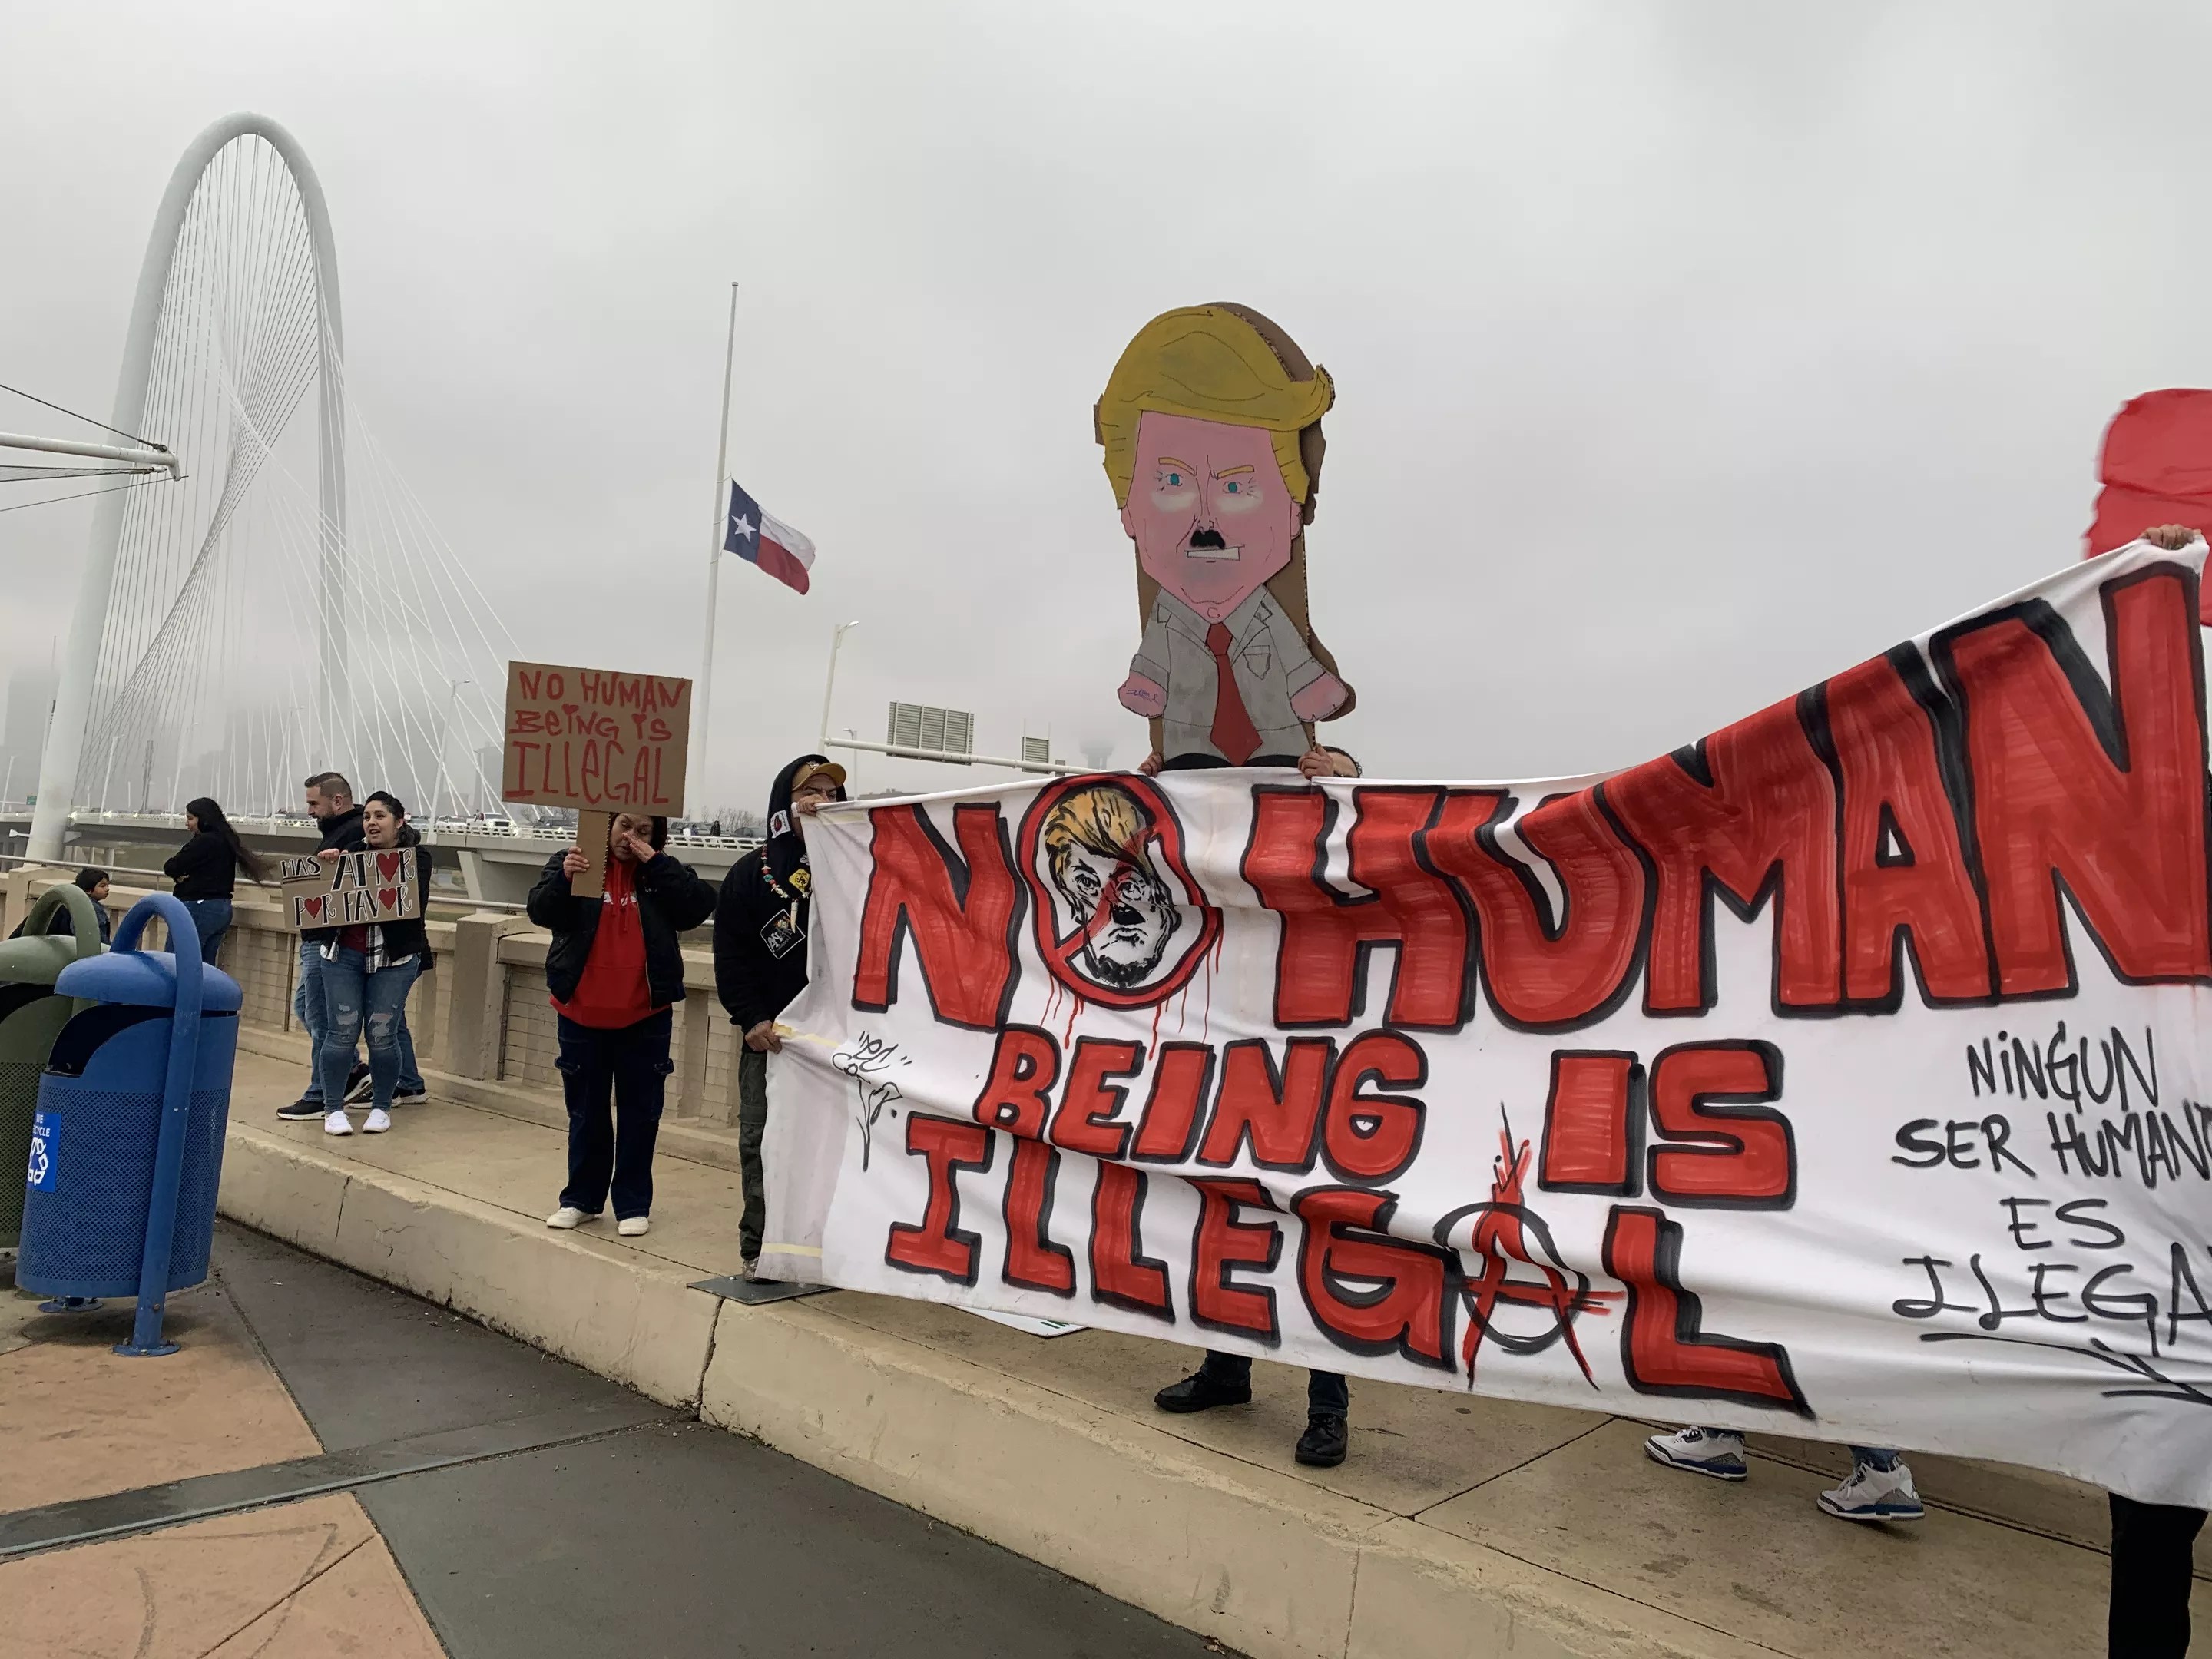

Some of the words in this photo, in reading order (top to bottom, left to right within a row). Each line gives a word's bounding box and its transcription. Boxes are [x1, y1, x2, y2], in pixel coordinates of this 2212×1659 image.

[519, 670, 564, 700] NO
[580, 671, 686, 714] HUMAN
[1243, 561, 2212, 1033] HUMAN
[280, 856, 321, 878] MAS
[36, 1114, 44, 1124] WE
[972, 1024, 1428, 1185] BEING
[1538, 1038, 1797, 1210] IS
[1892, 1114, 2037, 1178] SER
[2046, 1098, 2212, 1189] HUMAN
[886, 1100, 1817, 1420] ILLEGAL
[1998, 1197, 2125, 1250] ES
[1892, 1243, 2212, 1357] ILEGA
